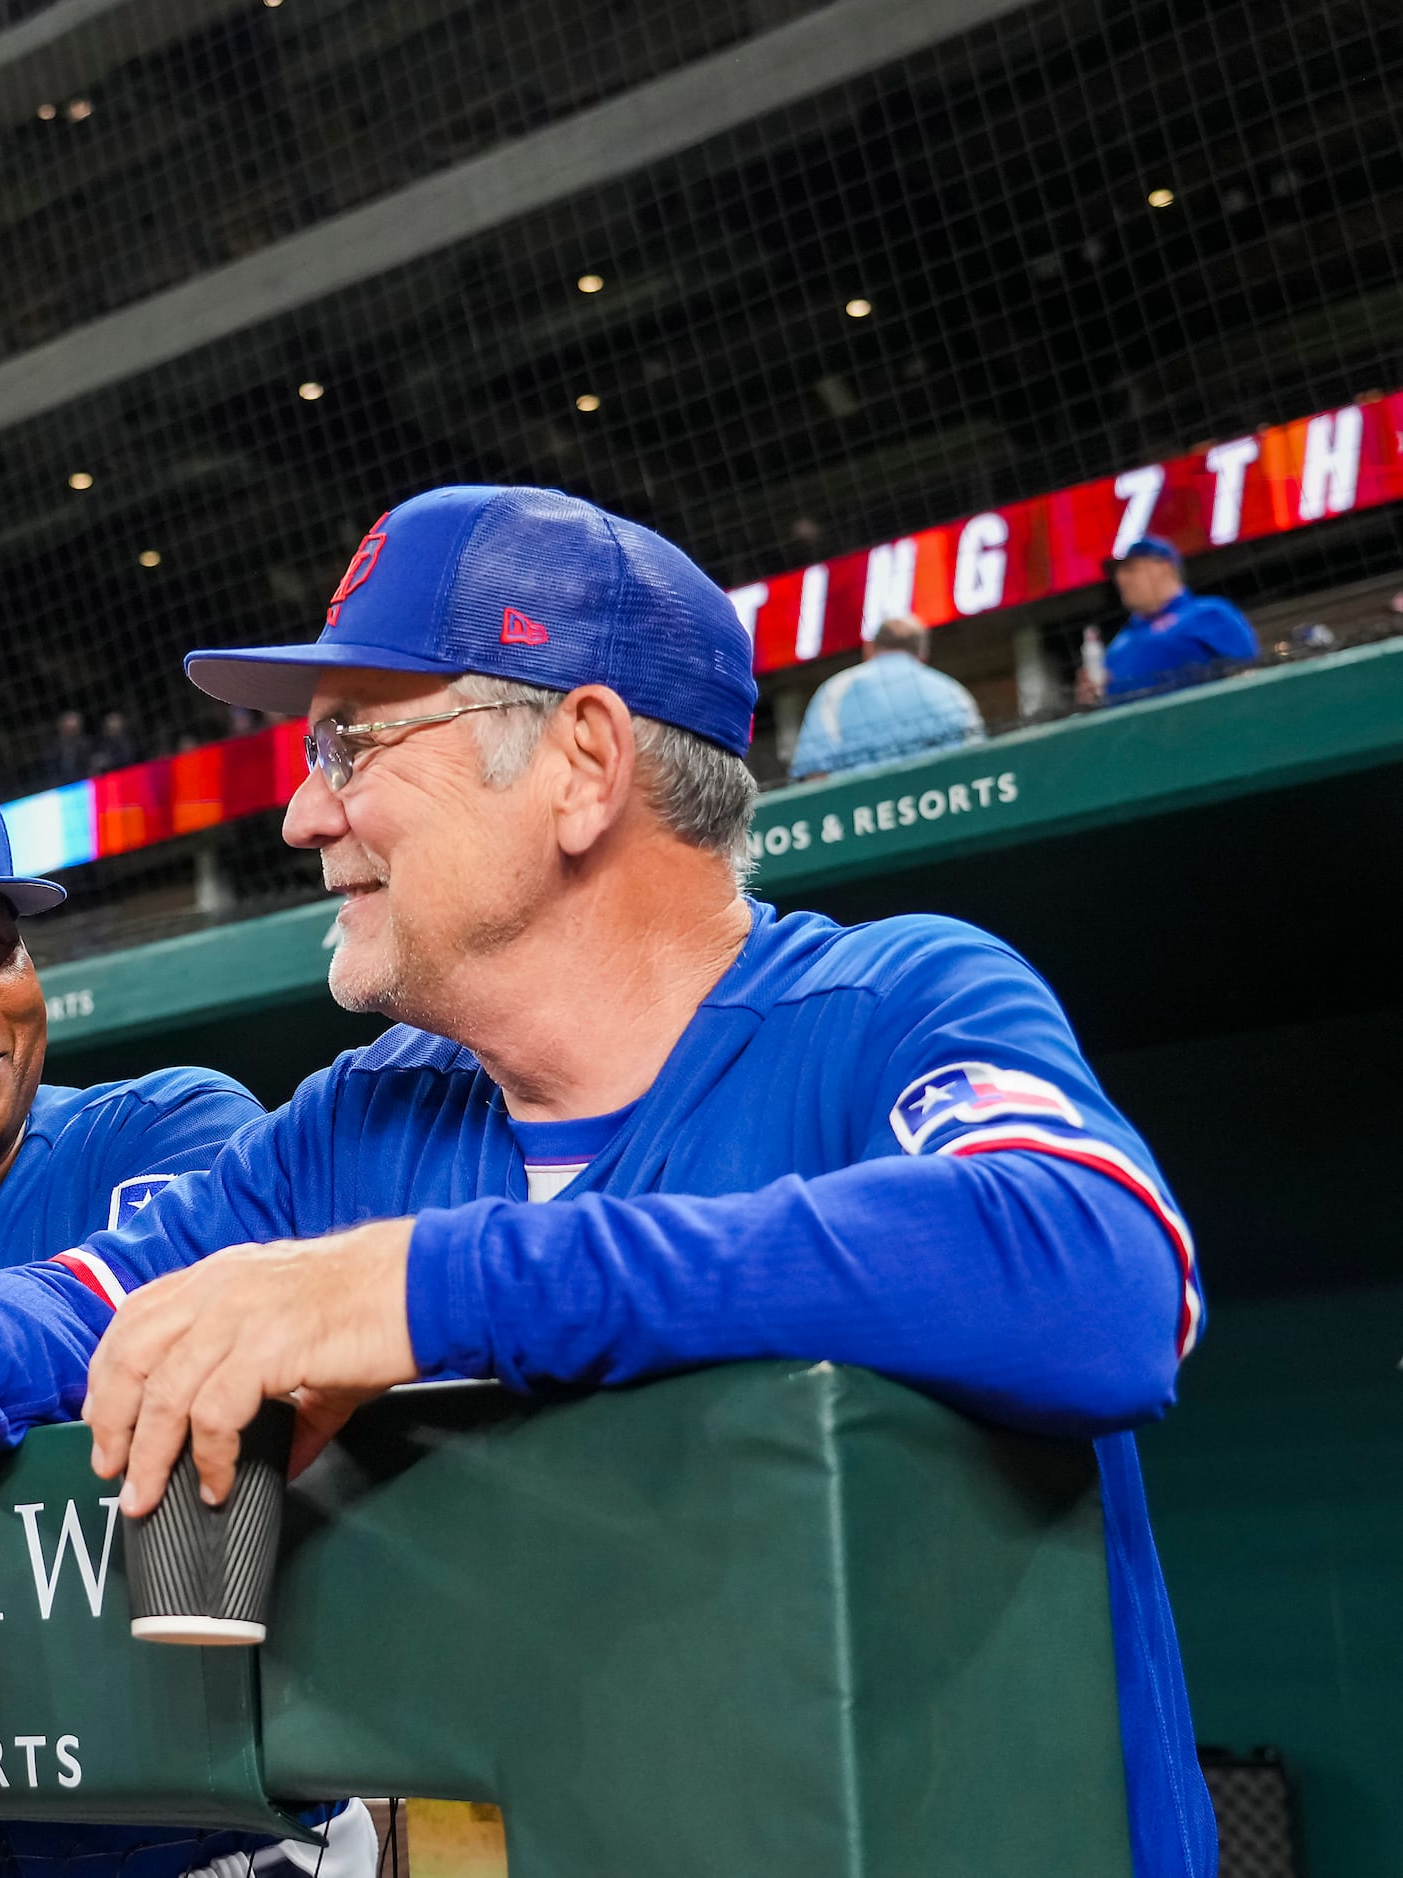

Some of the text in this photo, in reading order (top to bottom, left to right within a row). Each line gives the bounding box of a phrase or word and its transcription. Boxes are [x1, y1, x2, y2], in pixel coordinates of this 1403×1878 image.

[1113, 404, 1364, 560] 7TH
[821, 813, 844, 843] &
[853, 772, 1018, 836] RESORTS
